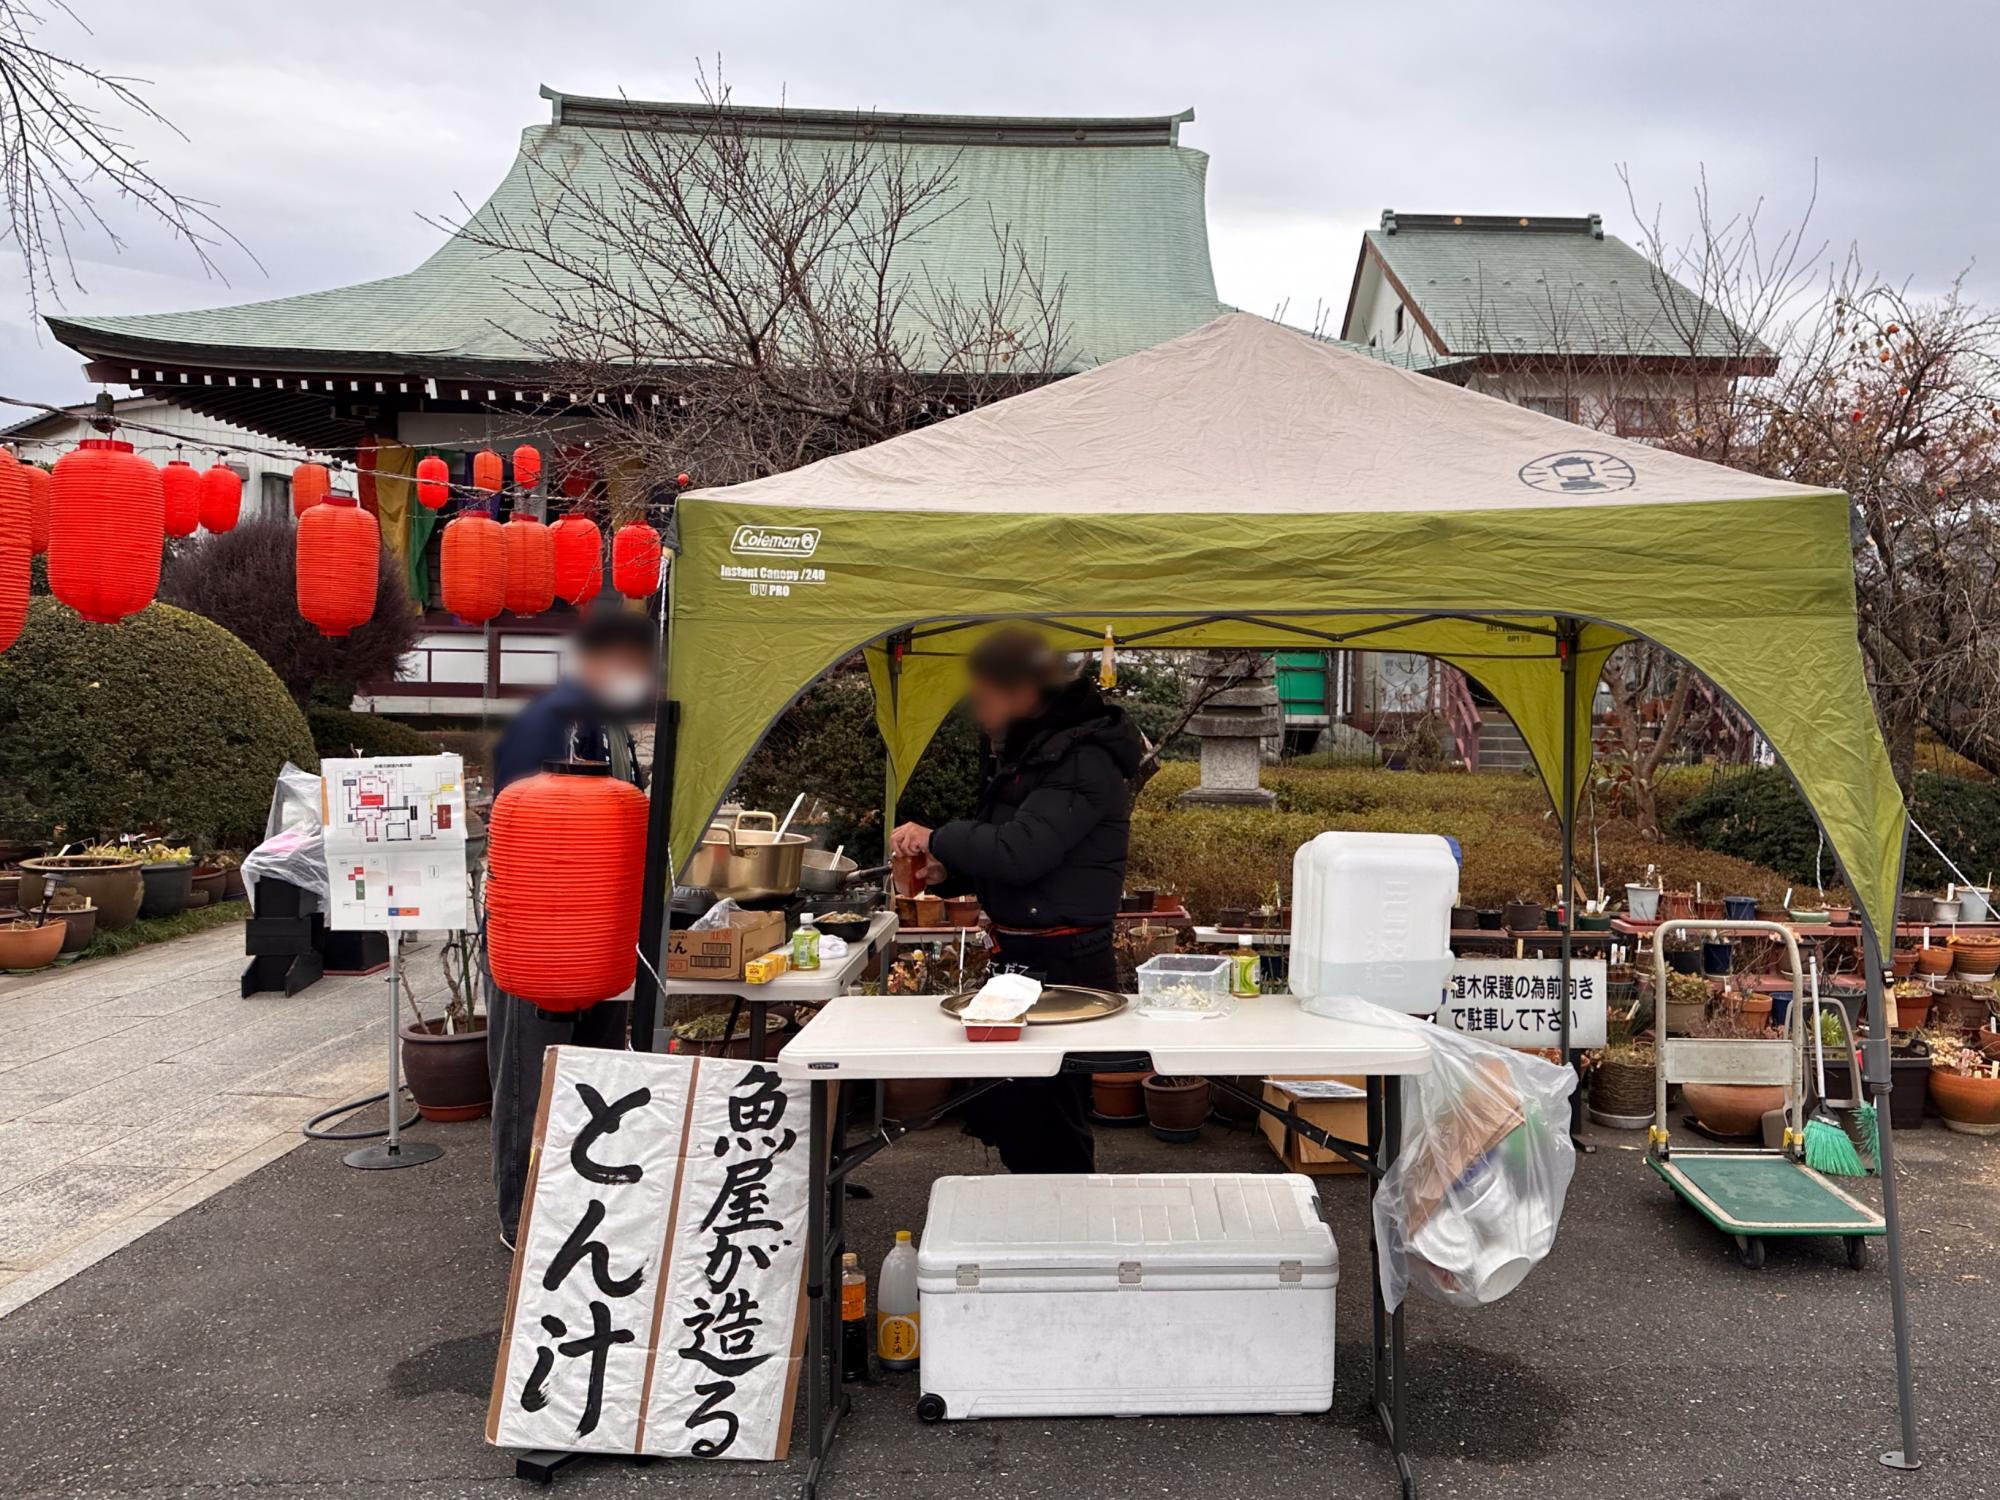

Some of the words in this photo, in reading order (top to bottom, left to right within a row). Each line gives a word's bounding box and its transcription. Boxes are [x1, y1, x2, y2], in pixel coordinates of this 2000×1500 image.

[738, 529, 801, 549] Coleman
[720, 565, 758, 579] Instant
[759, 566, 799, 581] Canopy
[800, 568, 826, 581] /240
[749, 583, 768, 597] UV
[769, 584, 790, 597] PRO
[1451, 974, 1594, 1001] 植木保護の為前向き
[520, 1083, 651, 1443] とん汁
[678, 1064, 797, 1458] 魚屋が造る
